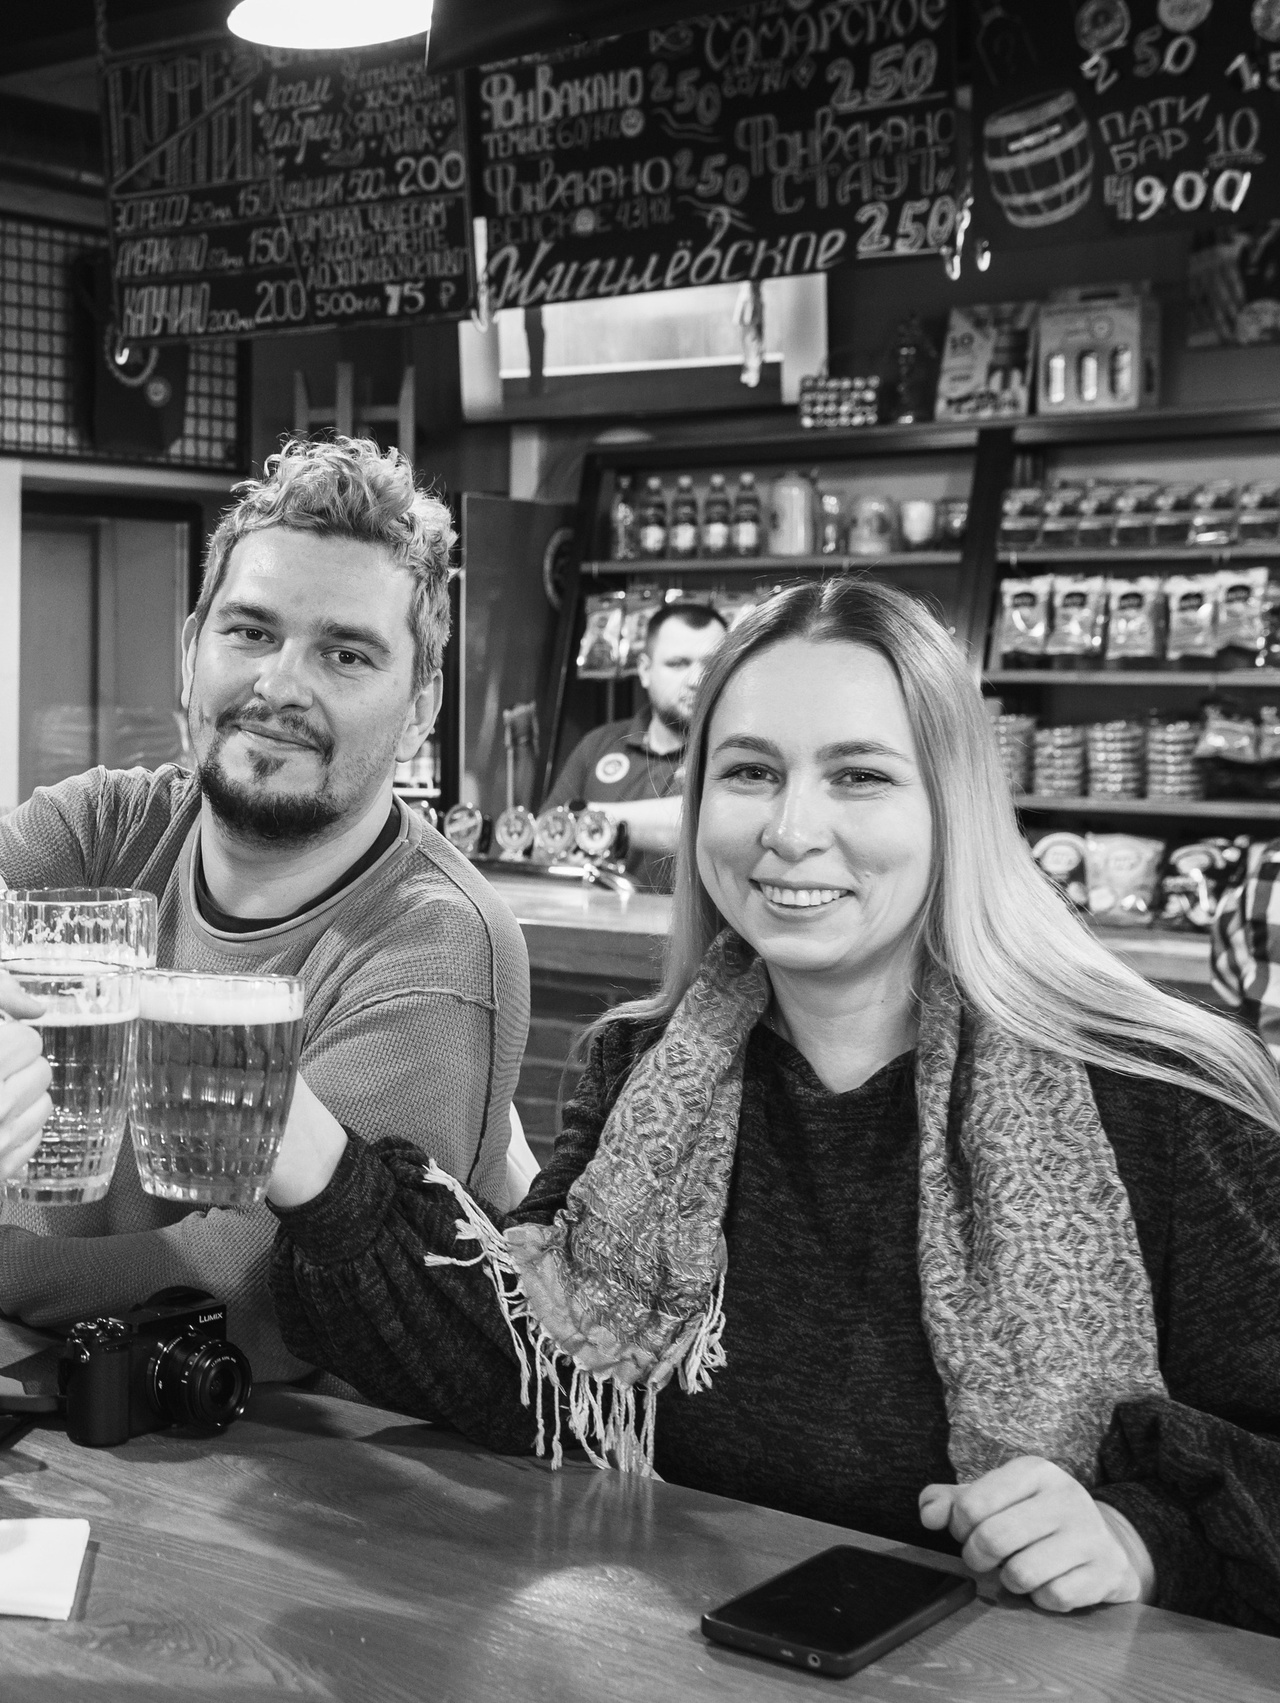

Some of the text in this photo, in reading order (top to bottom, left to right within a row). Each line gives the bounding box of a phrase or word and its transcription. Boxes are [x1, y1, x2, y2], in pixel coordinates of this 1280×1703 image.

[647, 61, 722, 126] 250
[825, 38, 938, 108] 250
[1098, 93, 1260, 156] ПАТИ 10
[395, 151, 466, 195] 200
[673, 148, 750, 204] 250
[1109, 127, 1190, 174] БАР
[249, 227, 290, 265] 150
[854, 196, 957, 252] 250
[255, 280, 307, 323] 200
[198, 1311, 224, 1325] LUMIX
